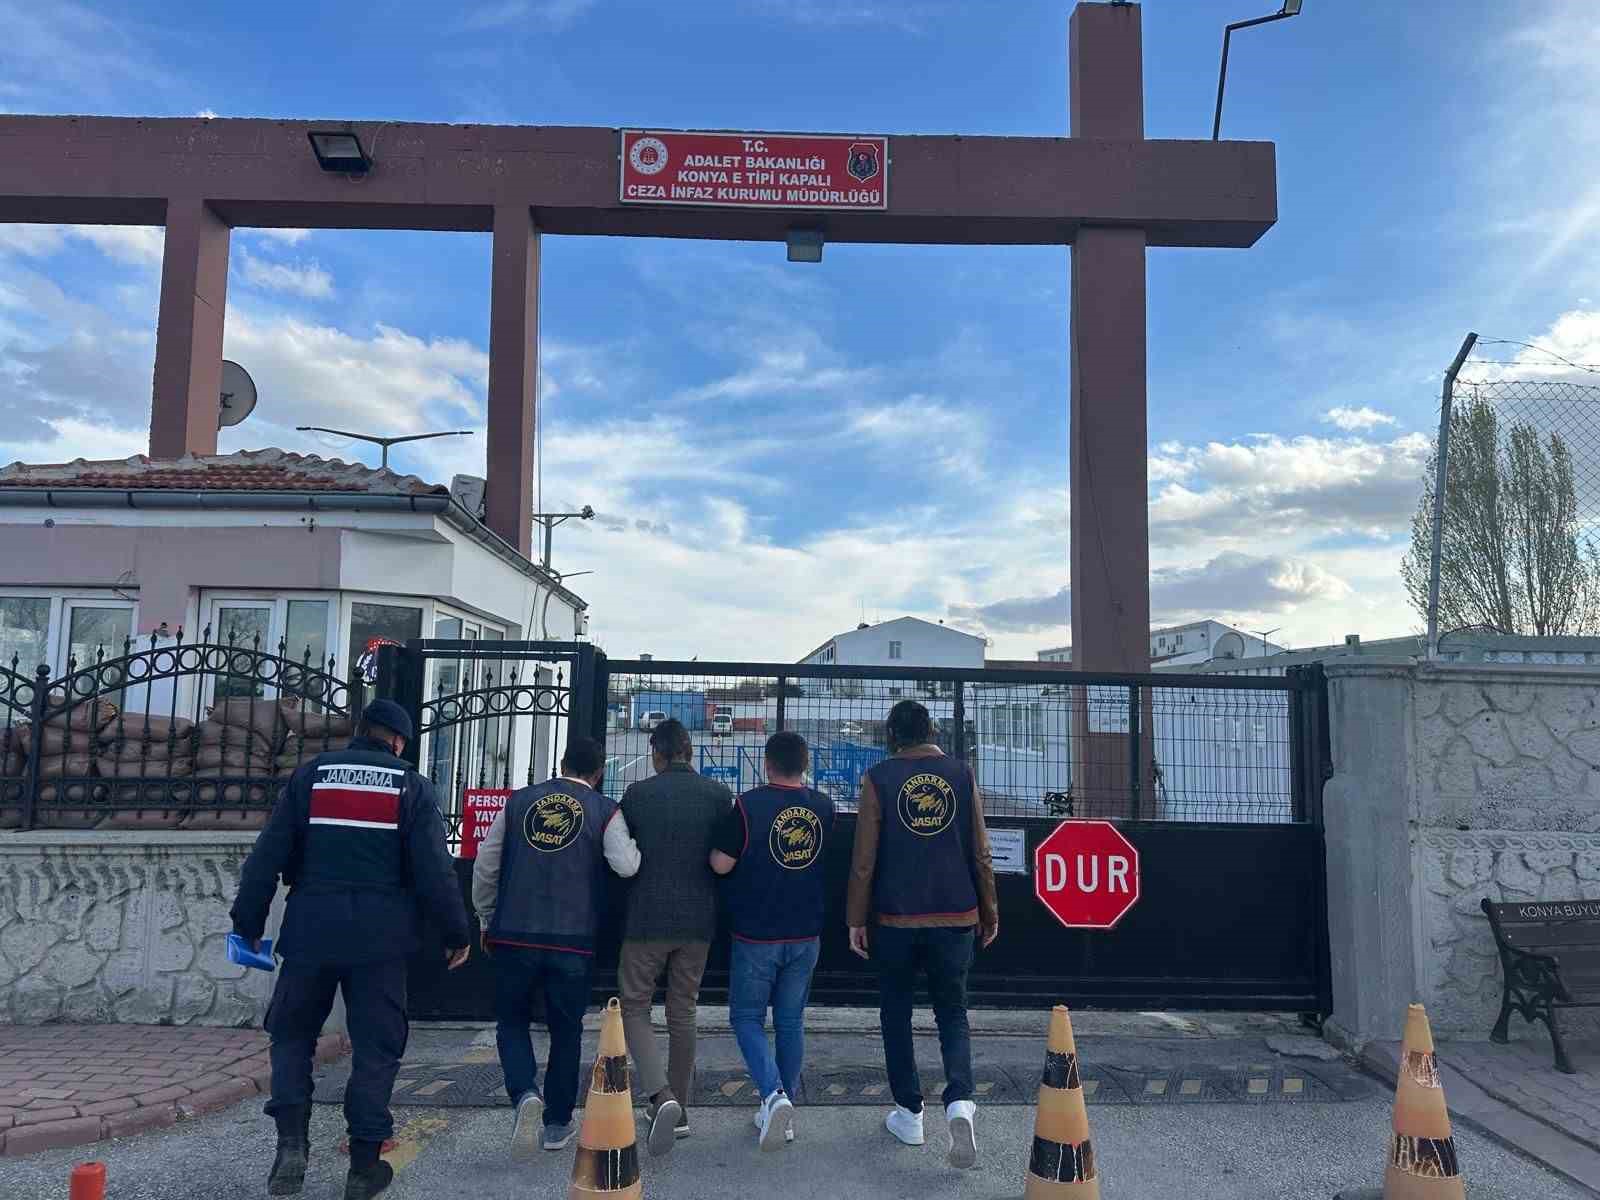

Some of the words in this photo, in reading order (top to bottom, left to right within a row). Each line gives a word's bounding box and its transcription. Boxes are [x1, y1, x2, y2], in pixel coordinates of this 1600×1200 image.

[742, 139, 769, 153] T.C.
[684, 154, 742, 169] ADALET
[745, 155, 825, 171] BAKANLIĞI
[677, 169, 728, 184] KONYA
[732, 171, 742, 184] E
[746, 170, 775, 185] TİPİ
[779, 172, 831, 187] KAPALI
[627, 184, 666, 198] CEZA
[671, 183, 713, 199] İNFAZ
[717, 187, 783, 202] KURUMU
[786, 186, 881, 204] MÜDÜRLÜĞÜ
[321, 768, 393, 788] JANDARMA
[902, 775, 952, 796] JANDARMA
[467, 794, 508, 807] PERSO
[535, 794, 584, 817] JANDARMA
[474, 810, 497, 822] YAY
[774, 808, 819, 833] JANDARMA
[911, 816, 944, 828] JASAT
[472, 825, 490, 838] AV
[531, 831, 565, 845] JASAT
[783, 849, 813, 863] JASAT
[1045, 853, 1129, 893] DUR
[1519, 904, 1562, 918] KONYA
